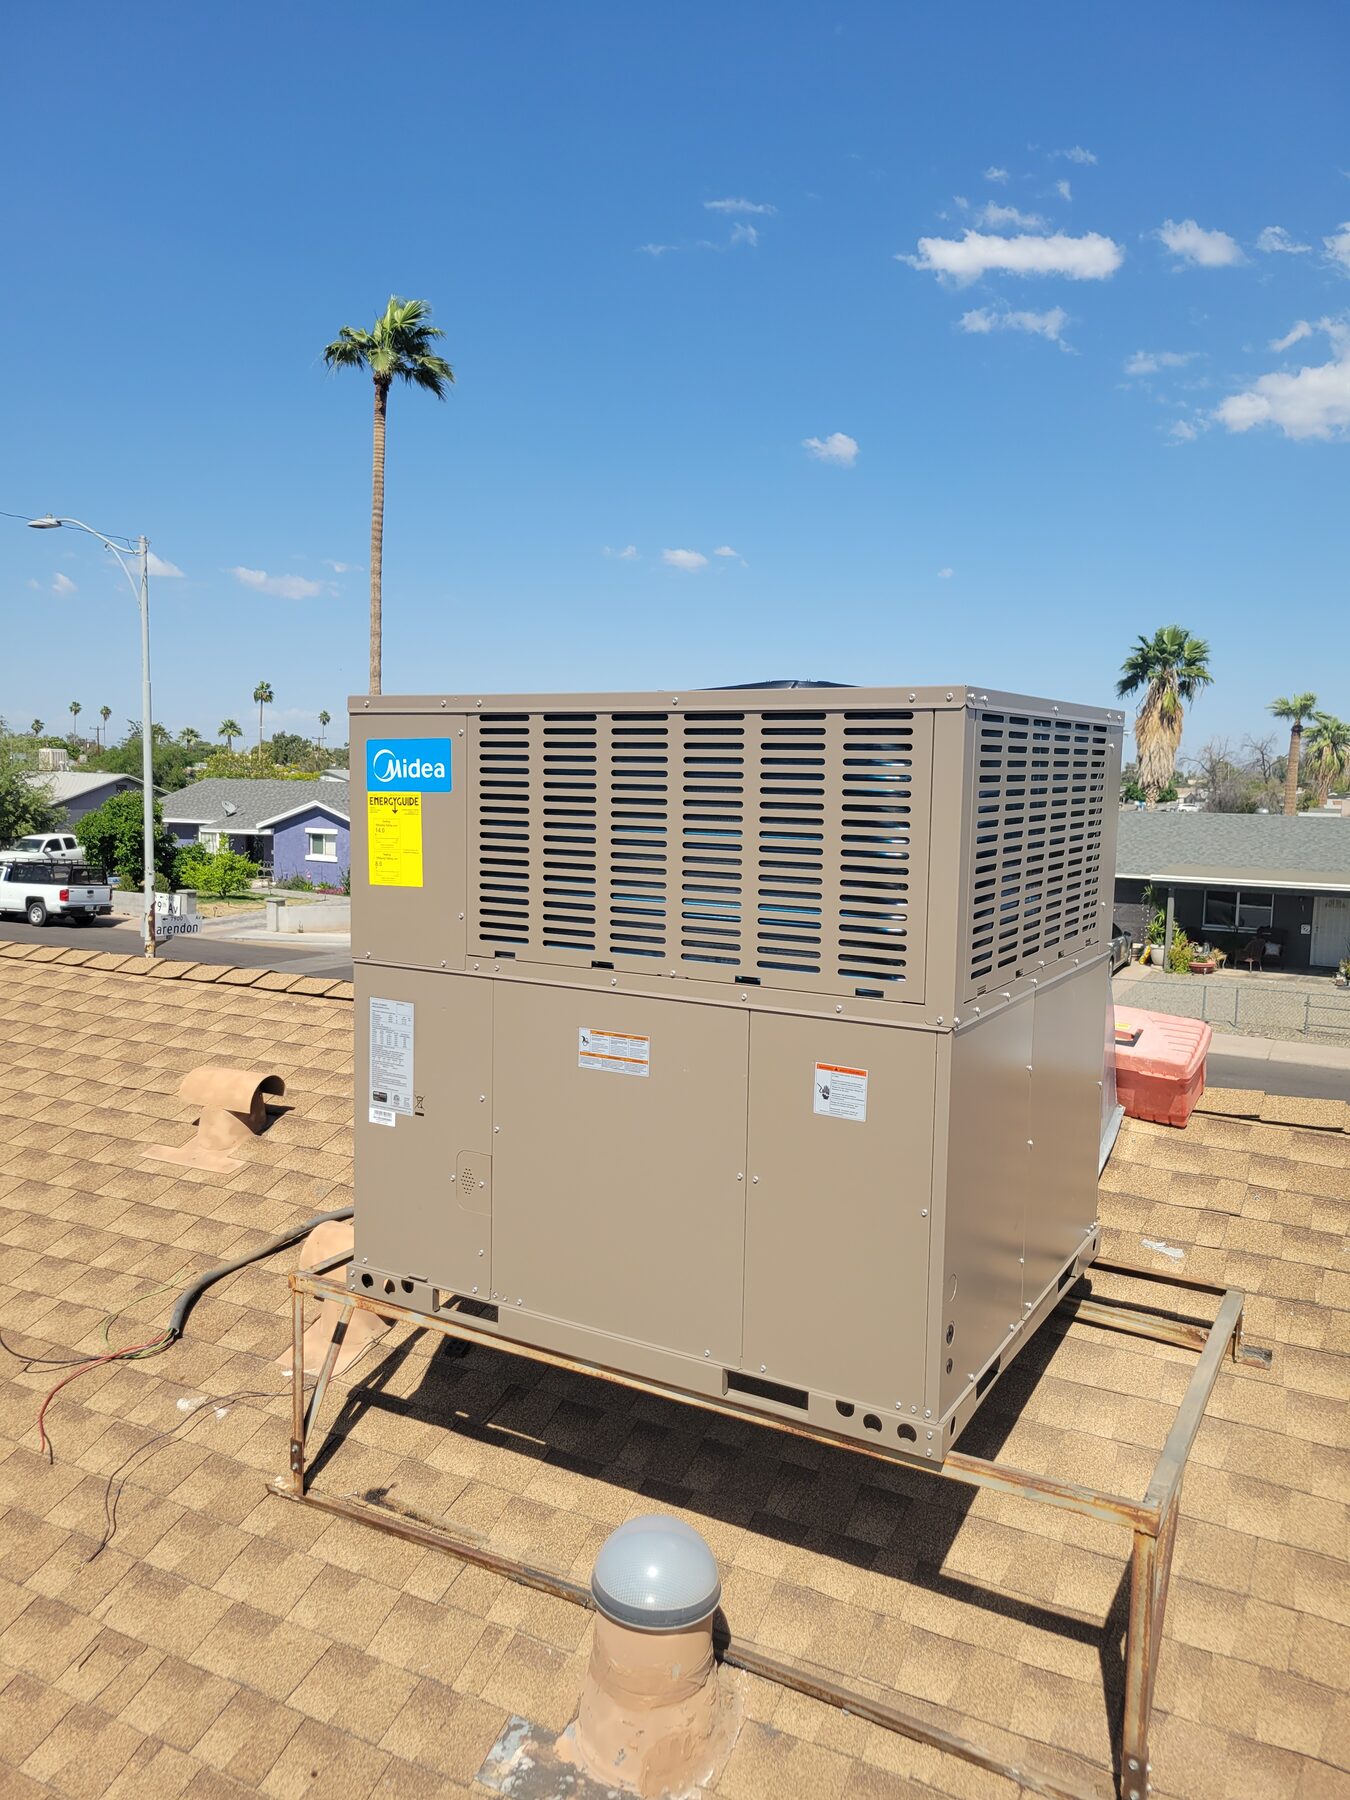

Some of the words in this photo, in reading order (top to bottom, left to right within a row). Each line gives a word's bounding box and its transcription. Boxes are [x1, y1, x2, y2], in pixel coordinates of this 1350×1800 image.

[373, 748, 445, 782] Midea
[168, 903, 178, 914] Av
[156, 923, 199, 935] arendon
